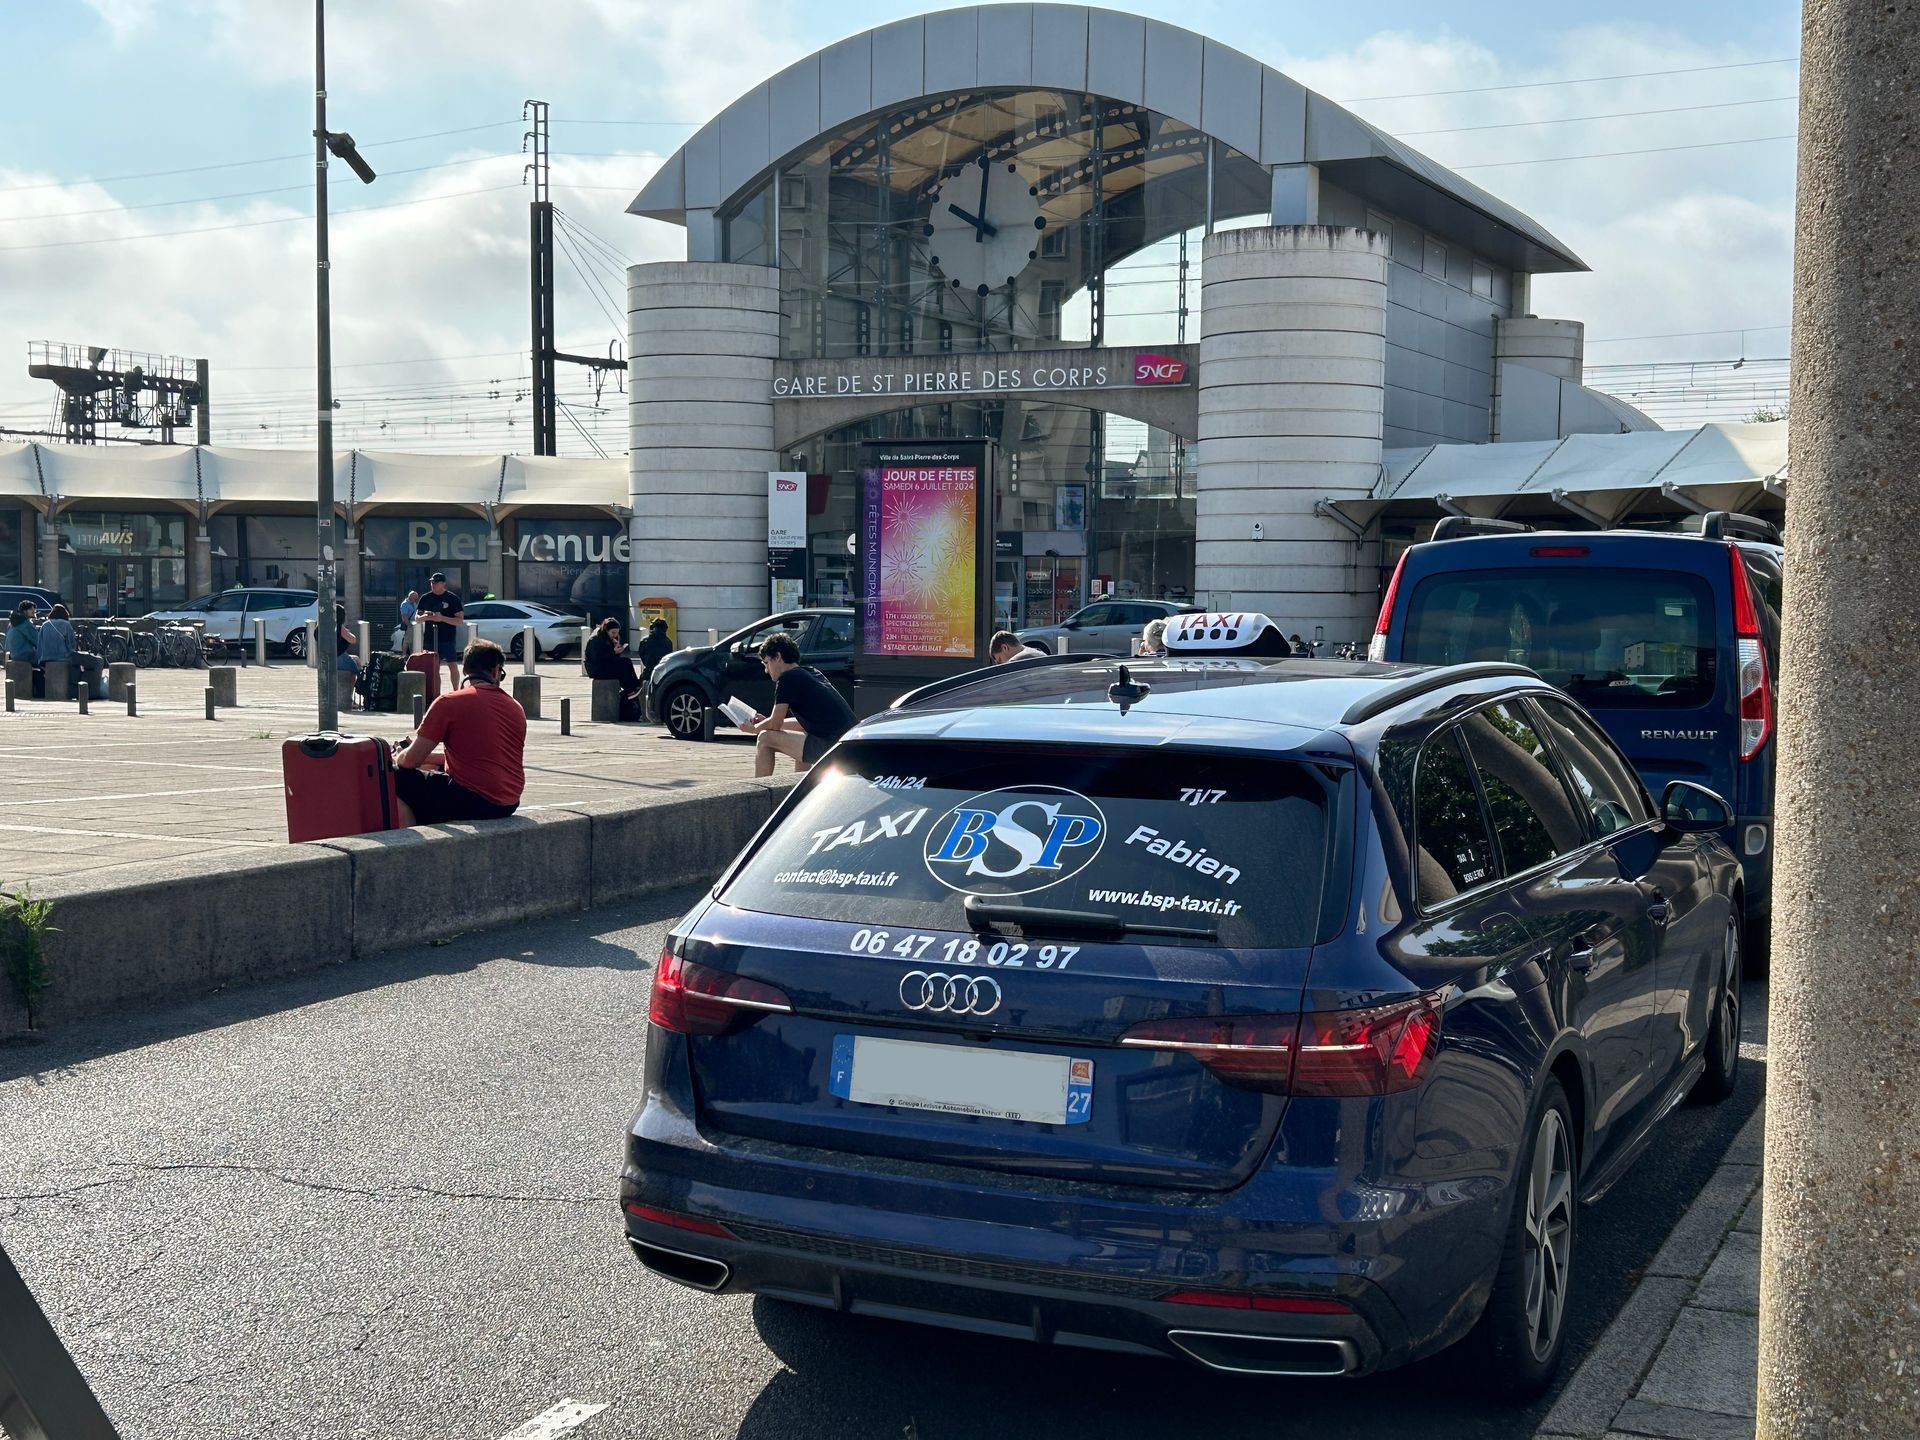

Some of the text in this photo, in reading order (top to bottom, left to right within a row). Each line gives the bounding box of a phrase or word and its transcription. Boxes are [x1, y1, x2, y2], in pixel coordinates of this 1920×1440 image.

[773, 366, 1107, 395] GARE DE ST PIERRE DES CORPS
[1136, 364, 1181, 379] SNCF
[884, 467, 975, 481] JOUR DE FÊTES
[777, 483, 797, 491] SNCF
[884, 482, 974, 491] SAMEDI 6 JUILLET 2024
[99, 532, 134, 545] AVIS
[867, 504, 879, 617] FÊTES MUNICIPALES
[1180, 614, 1244, 629] TAXI
[1641, 729, 1718, 740] RENAULT
[869, 775, 928, 790] 24h/24
[1179, 788, 1227, 807] 7j/7
[807, 807, 929, 856] TAXI
[927, 800, 1101, 878] BSP
[1124, 825, 1241, 885] Fabien
[773, 869, 900, 888] contact@bsp-taxi.fr
[1088, 888, 1242, 917] www.bsp-taxi.fr
[850, 929, 1080, 969] 06 47 18 02 97
[837, 1070, 845, 1083] F
[1068, 1091, 1091, 1113] 27
